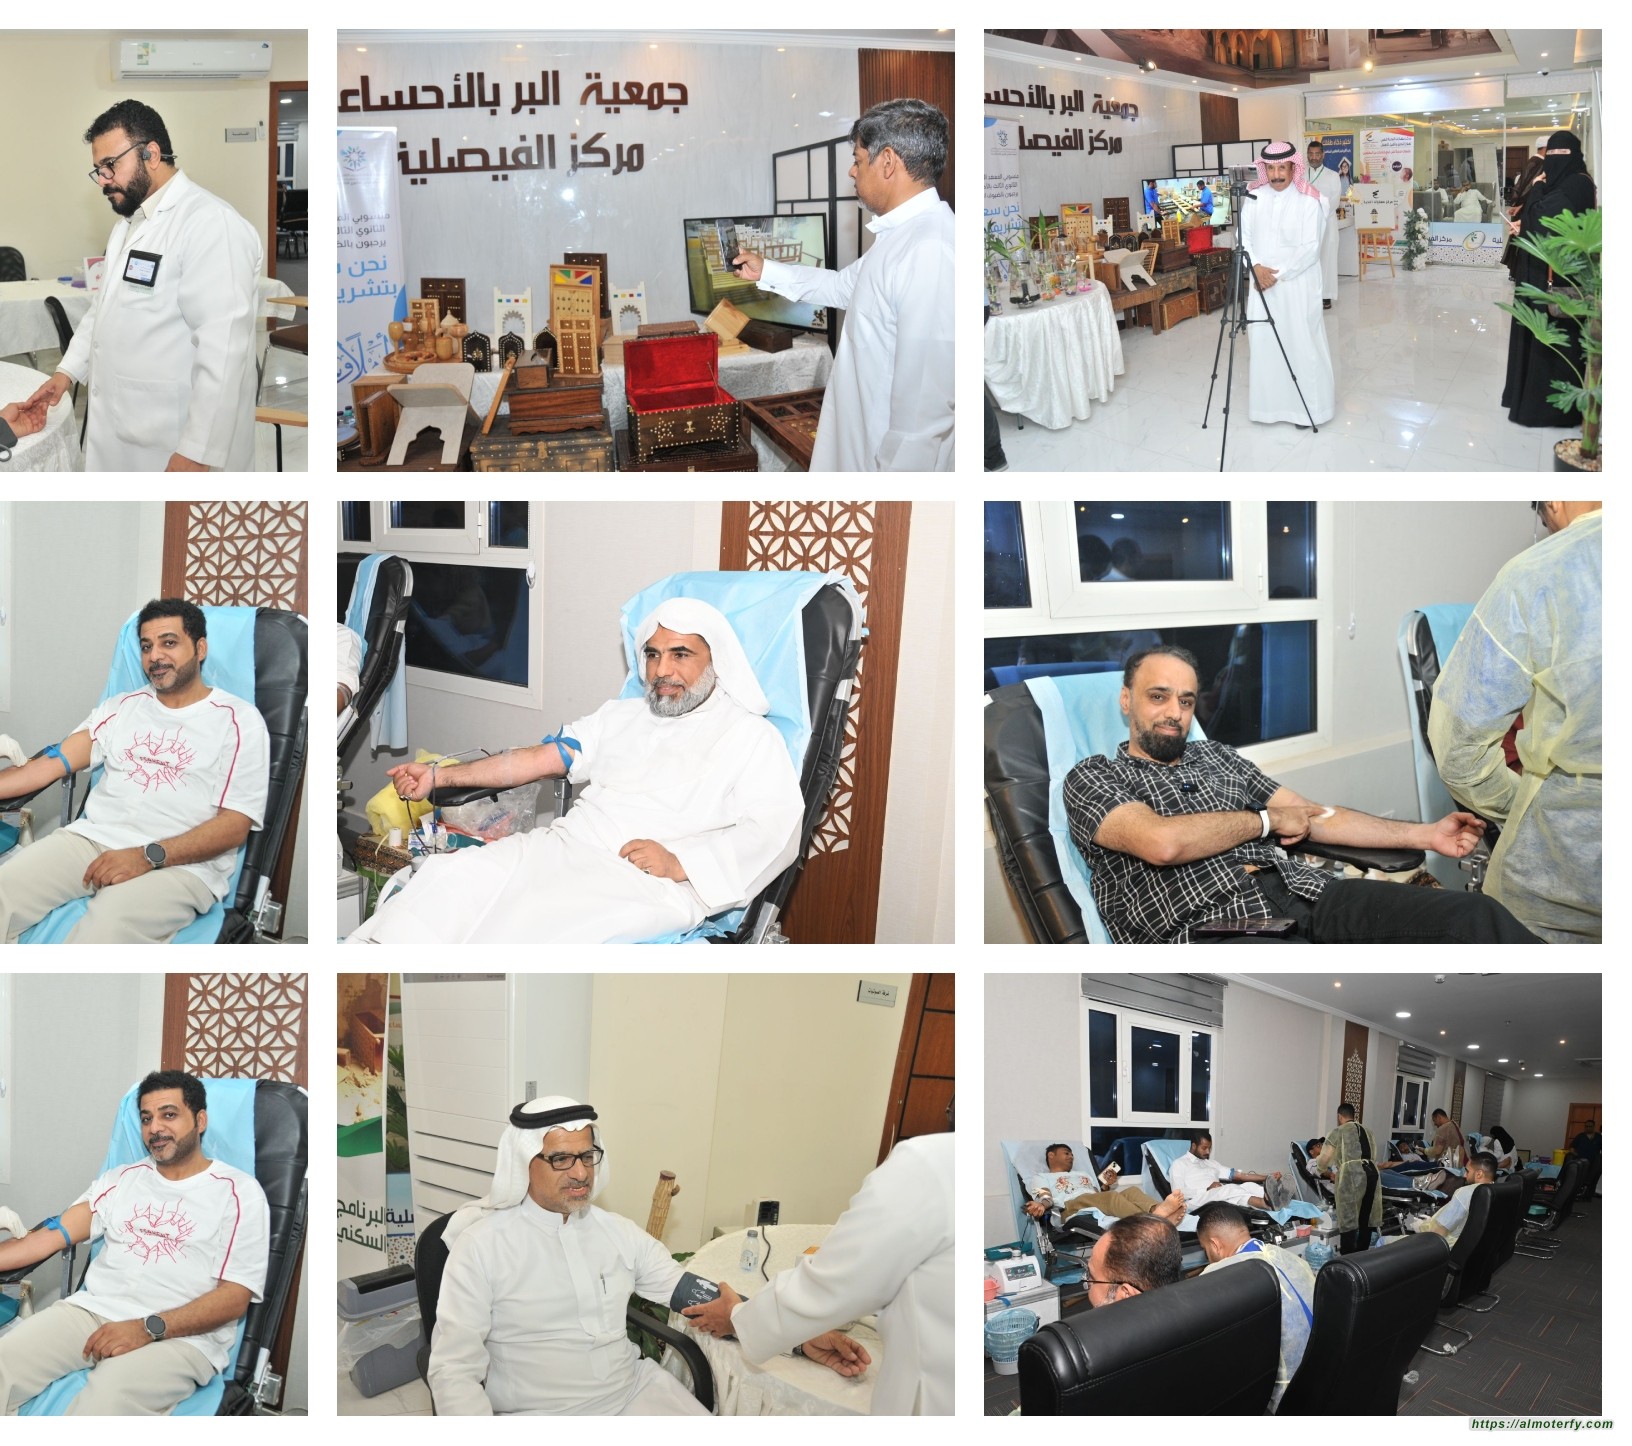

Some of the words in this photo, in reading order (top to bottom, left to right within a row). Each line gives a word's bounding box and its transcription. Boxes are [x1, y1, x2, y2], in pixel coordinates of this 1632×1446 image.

[337, 71, 501, 116] بالأحساء
[511, 70, 560, 115] البر
[580, 72, 688, 114] جمعية
[1060, 89, 1085, 116] البر
[1092, 93, 1139, 122] جمعية
[566, 132, 645, 177] مركز
[1018, 126, 1085, 157] الفيصل
[1088, 129, 1123, 156] مركز
[355, 224, 386, 236] الثانوي
[355, 238, 387, 249] يرحبون
[348, 255, 388, 278] نحن
[337, 279, 398, 304] بتشري
